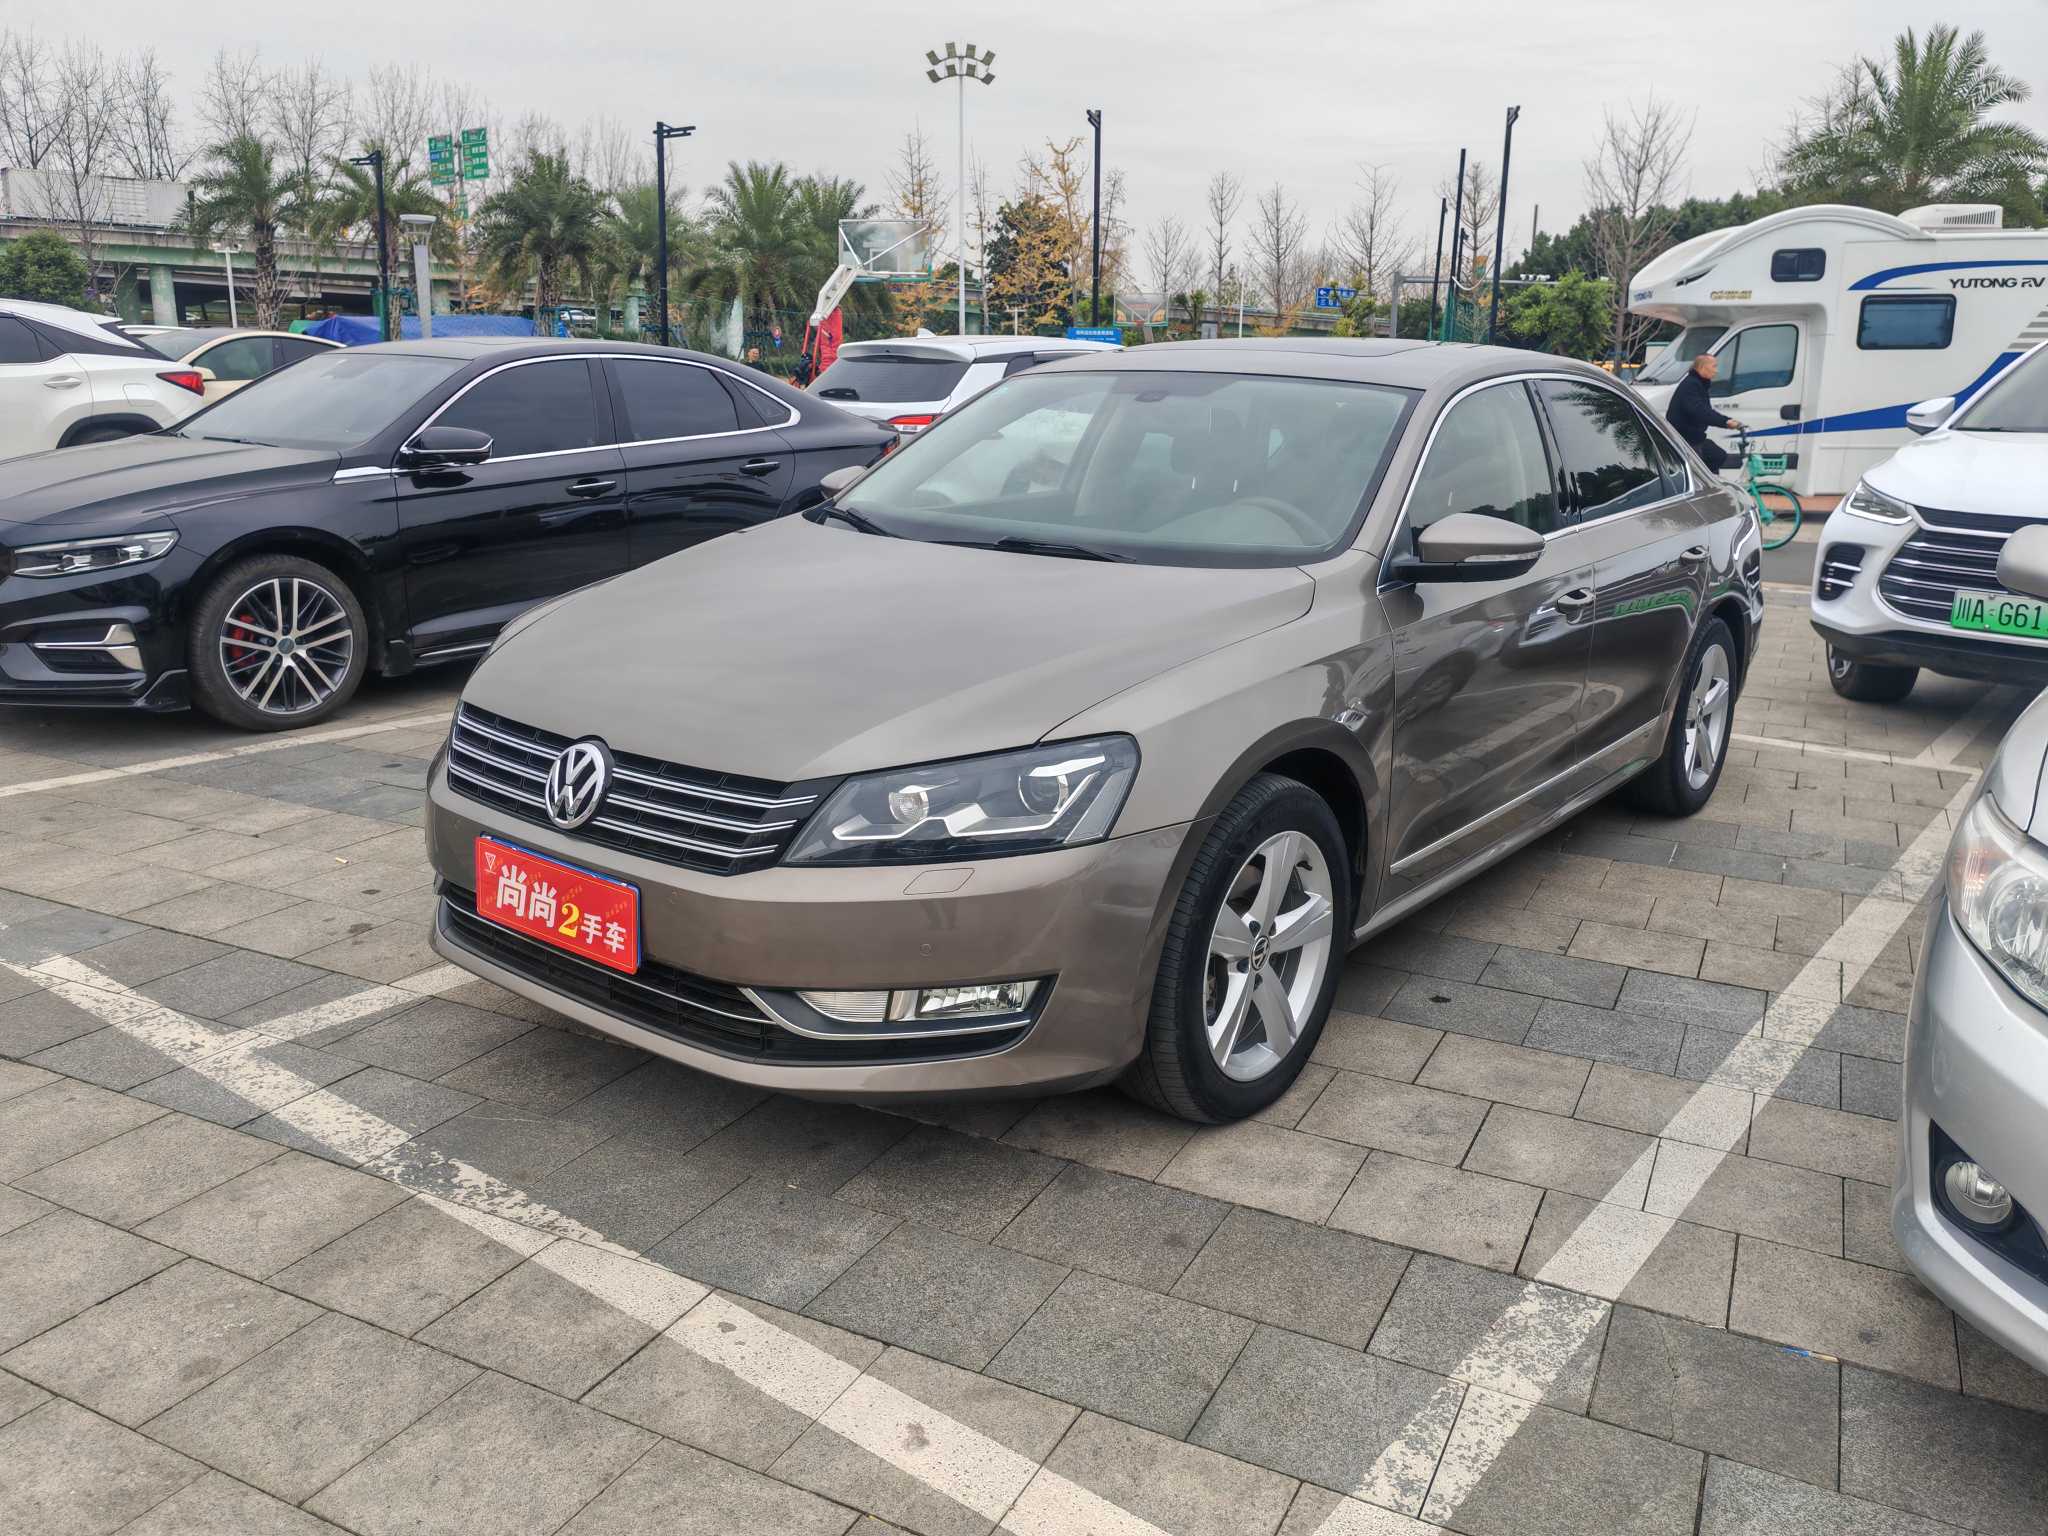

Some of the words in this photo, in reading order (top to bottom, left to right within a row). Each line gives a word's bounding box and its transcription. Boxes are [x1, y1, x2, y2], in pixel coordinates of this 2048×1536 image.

[1949, 278, 2017, 288] YUTONG
[2021, 277, 2046, 288] RV
[1955, 597, 2048, 632] 川A·G61
[496, 865, 626, 953] 尚尚2手车
